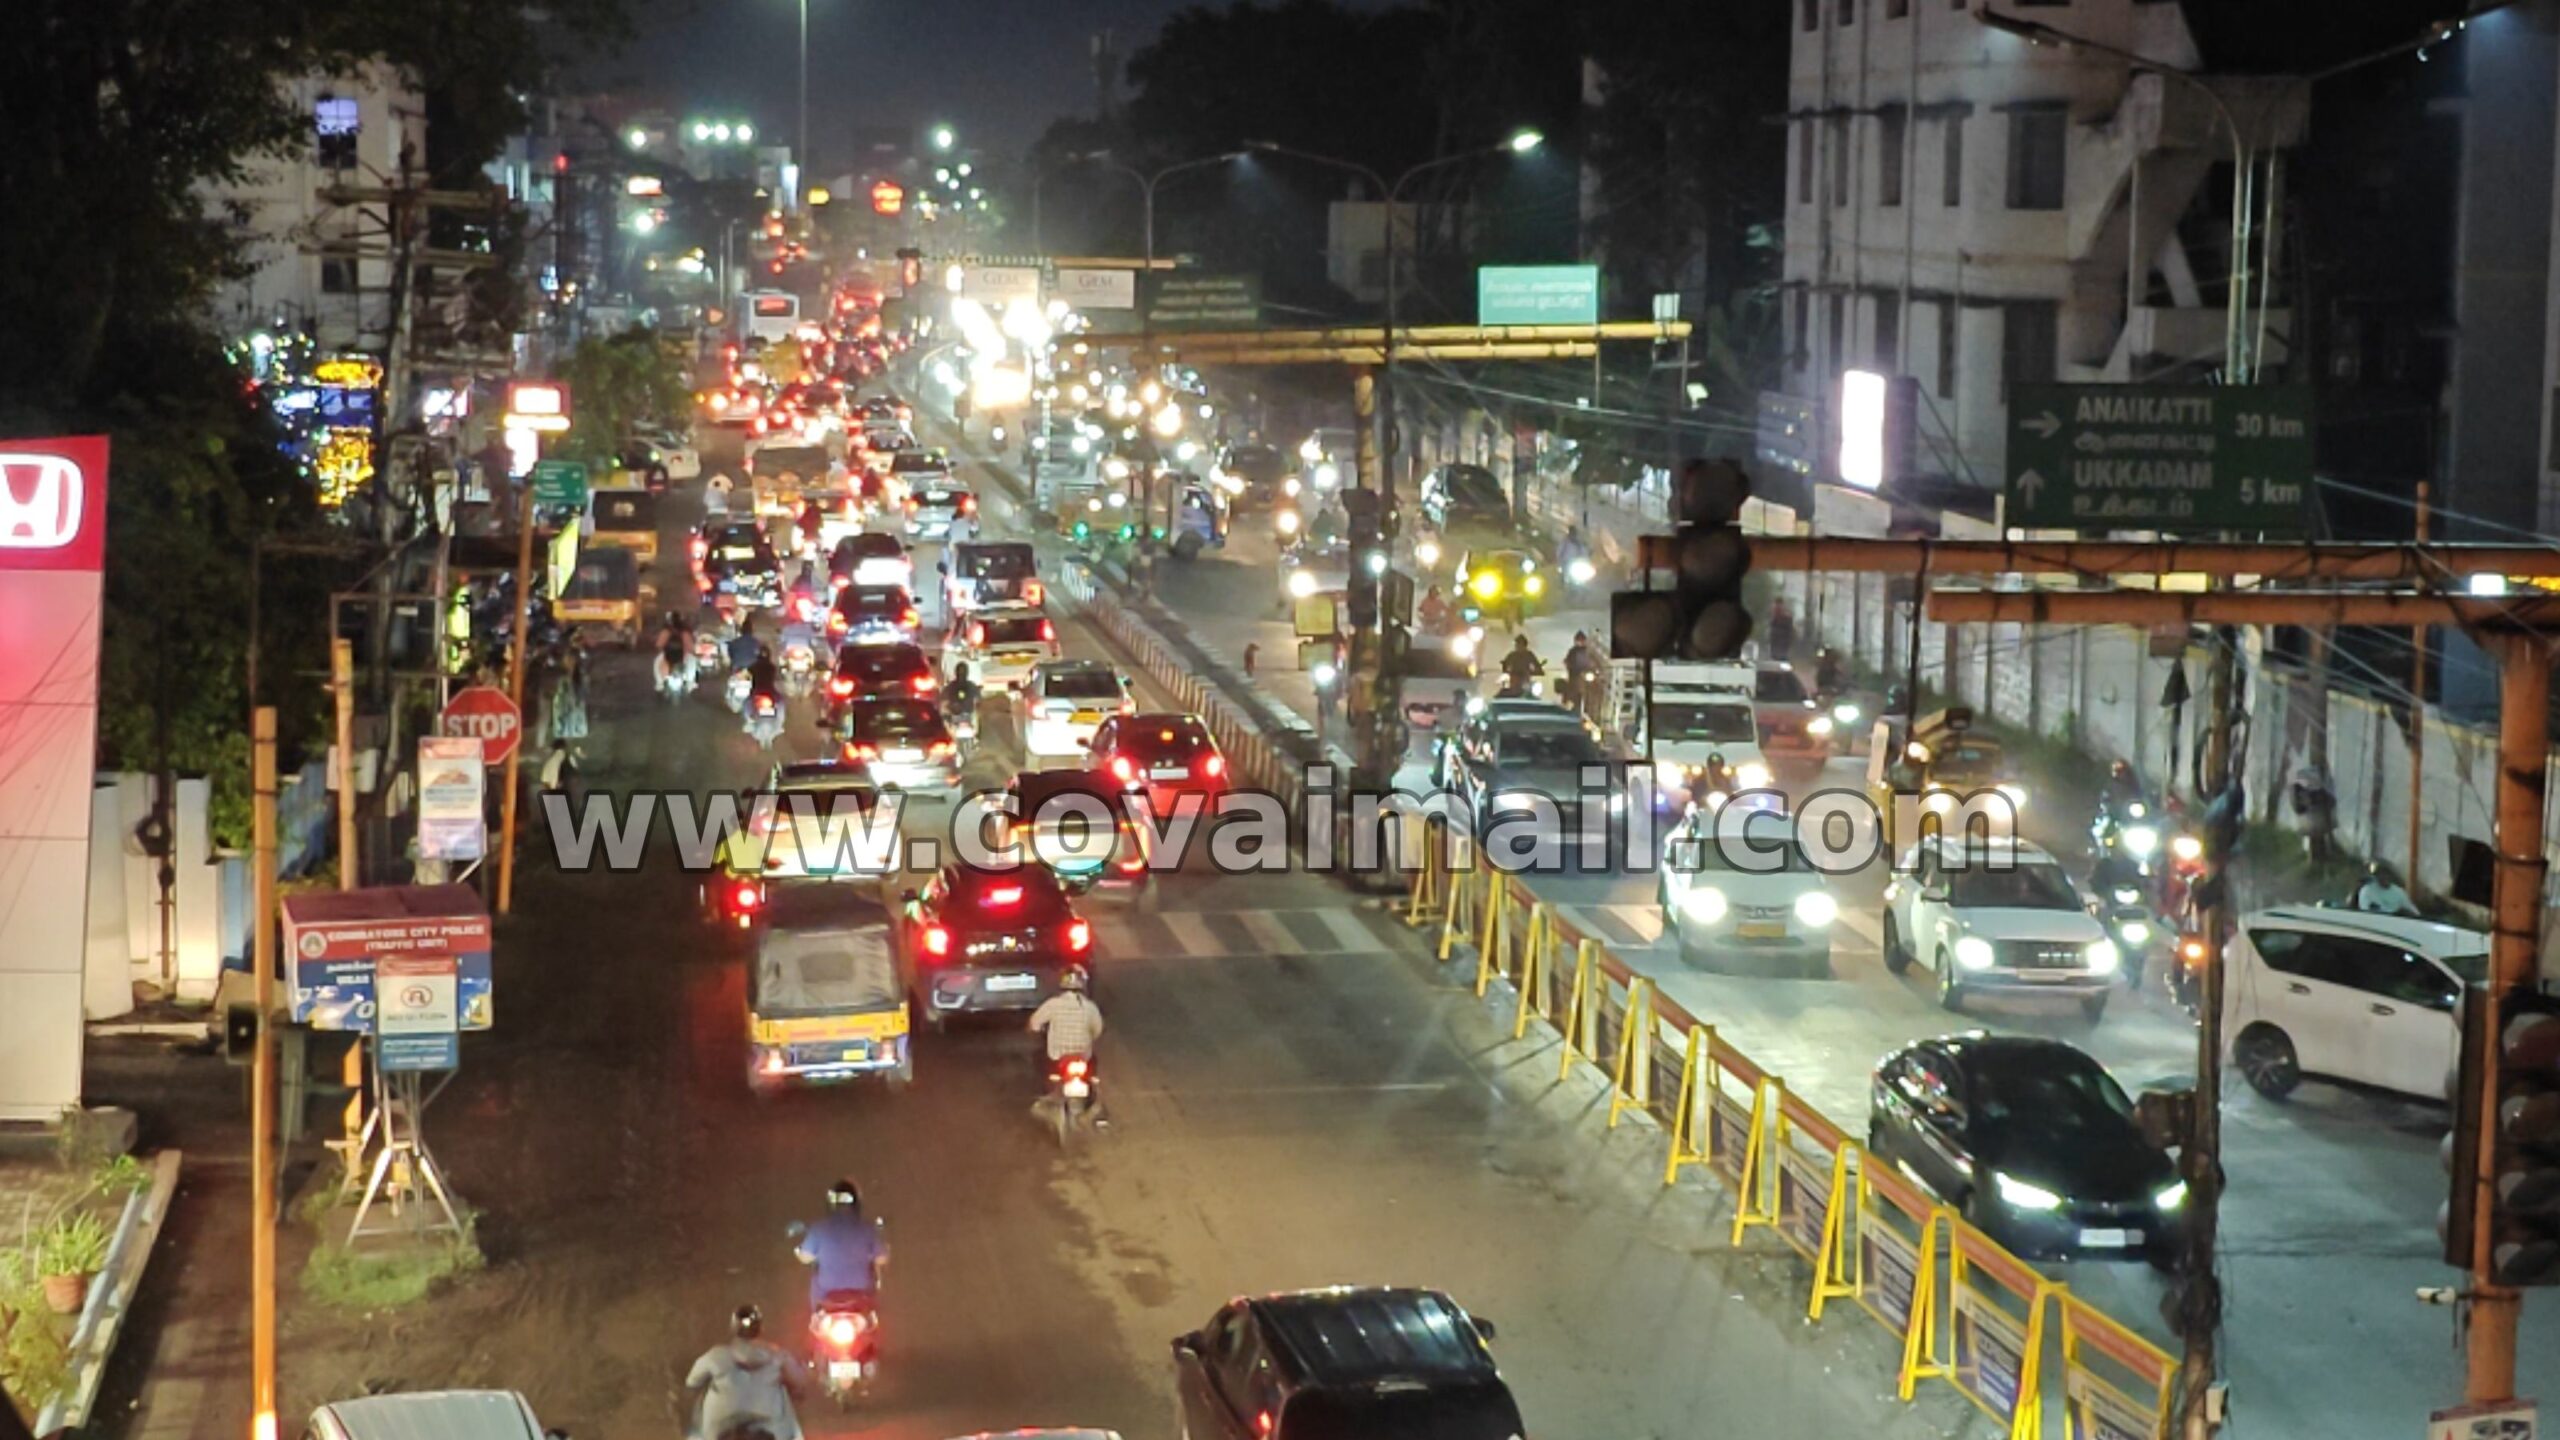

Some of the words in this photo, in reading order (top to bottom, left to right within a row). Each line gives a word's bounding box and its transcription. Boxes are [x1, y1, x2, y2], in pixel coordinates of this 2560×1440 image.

[2075, 396, 2213, 424] ANAIKATTI
[2235, 413, 2263, 438] 30
[2268, 413, 2305, 438] km
[2073, 460, 2213, 489] UKKADAM
[2239, 477, 2255, 504] 5
[2263, 478, 2303, 504] km
[446, 712, 518, 739] STOP
[410, 926, 438, 938] CITY
